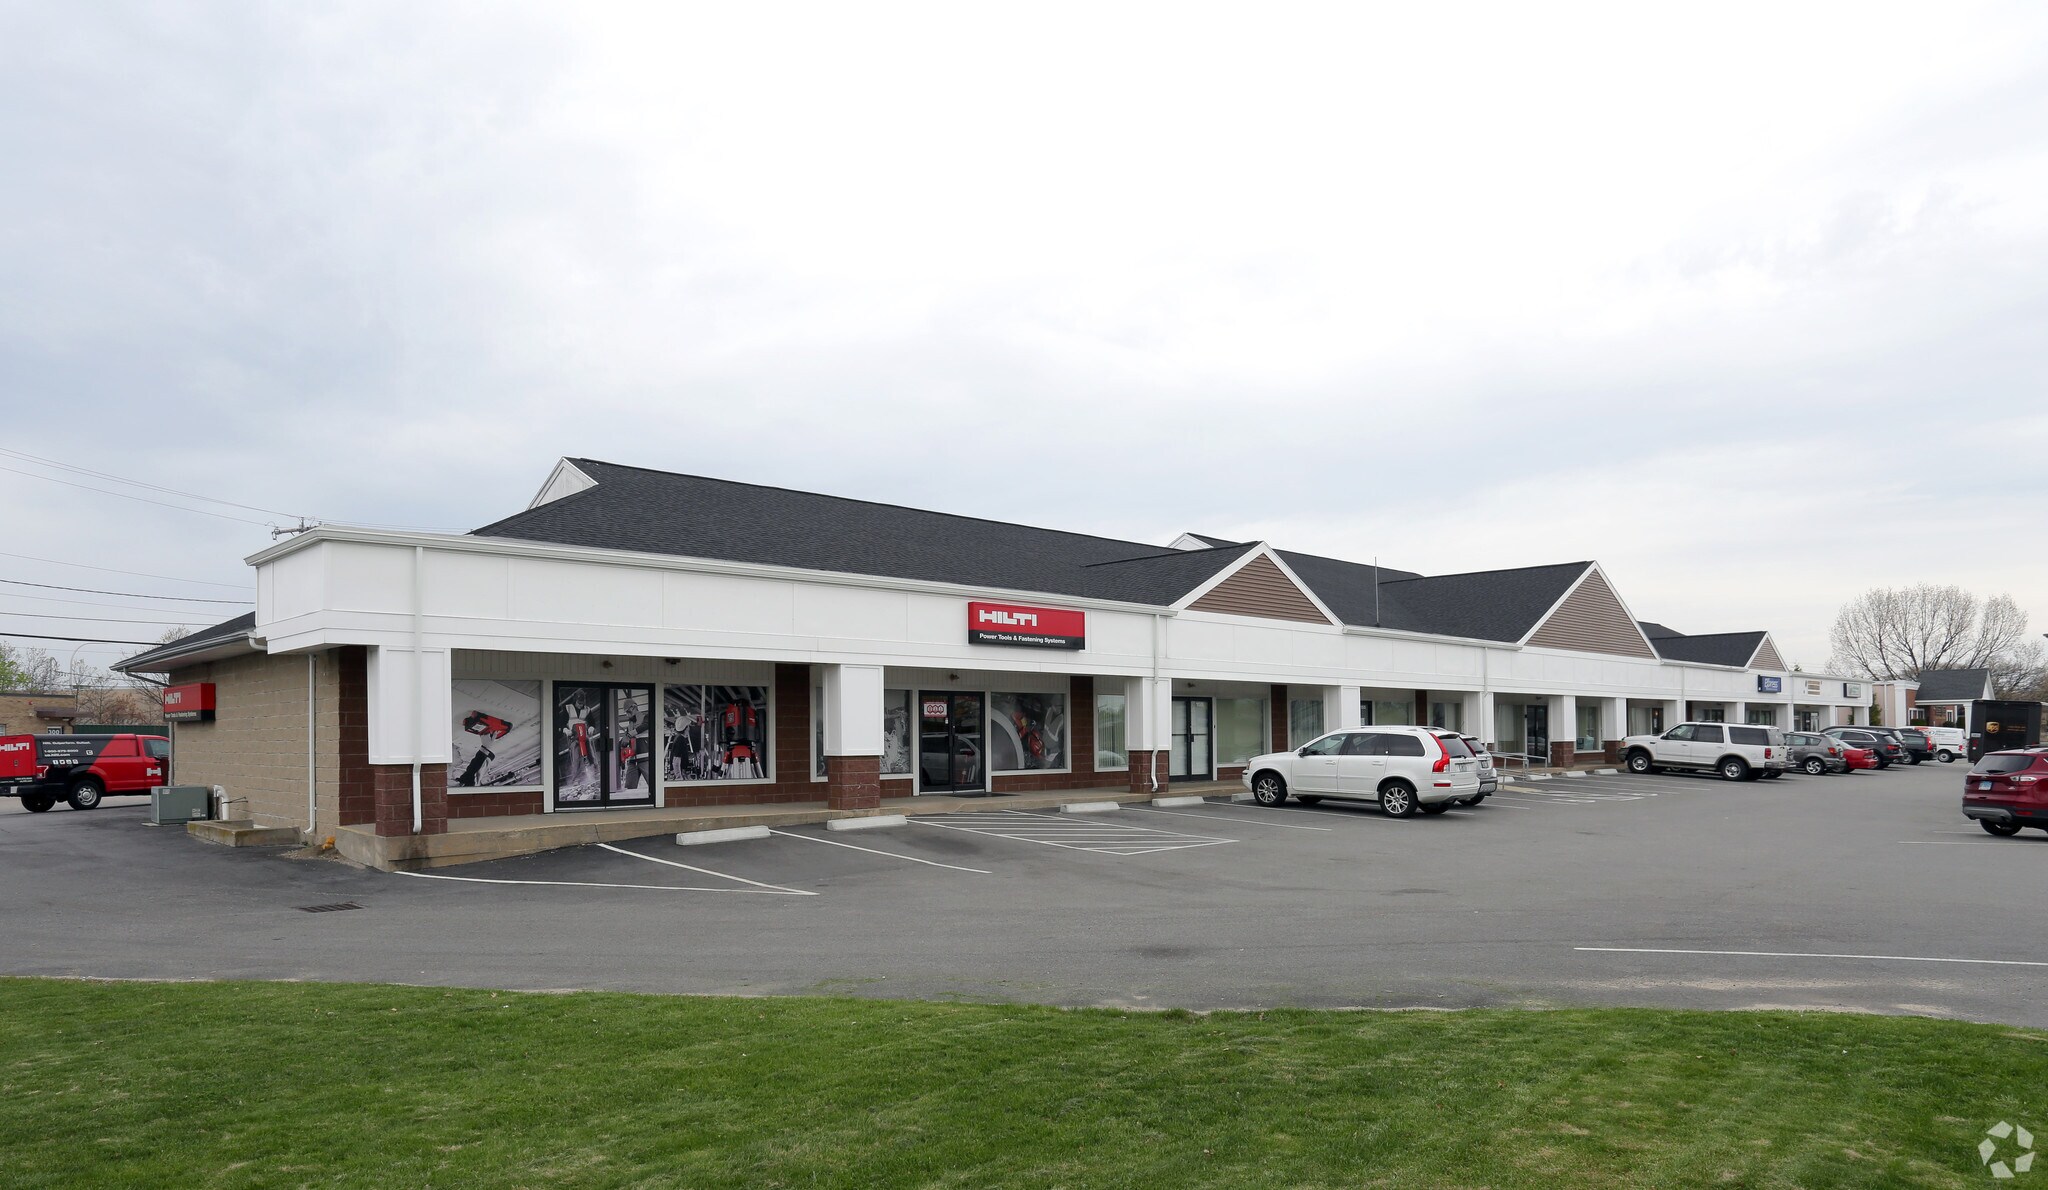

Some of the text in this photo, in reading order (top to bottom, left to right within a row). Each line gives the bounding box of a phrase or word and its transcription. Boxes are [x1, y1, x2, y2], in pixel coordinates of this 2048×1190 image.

[979, 609, 1037, 627] HILTI
[979, 632, 998, 640] Power
[998, 633, 1012, 641] Tools
[1018, 635, 1044, 644] Fastening
[165, 692, 181, 704] HILTI
[0, 742, 30, 751] HILTI
